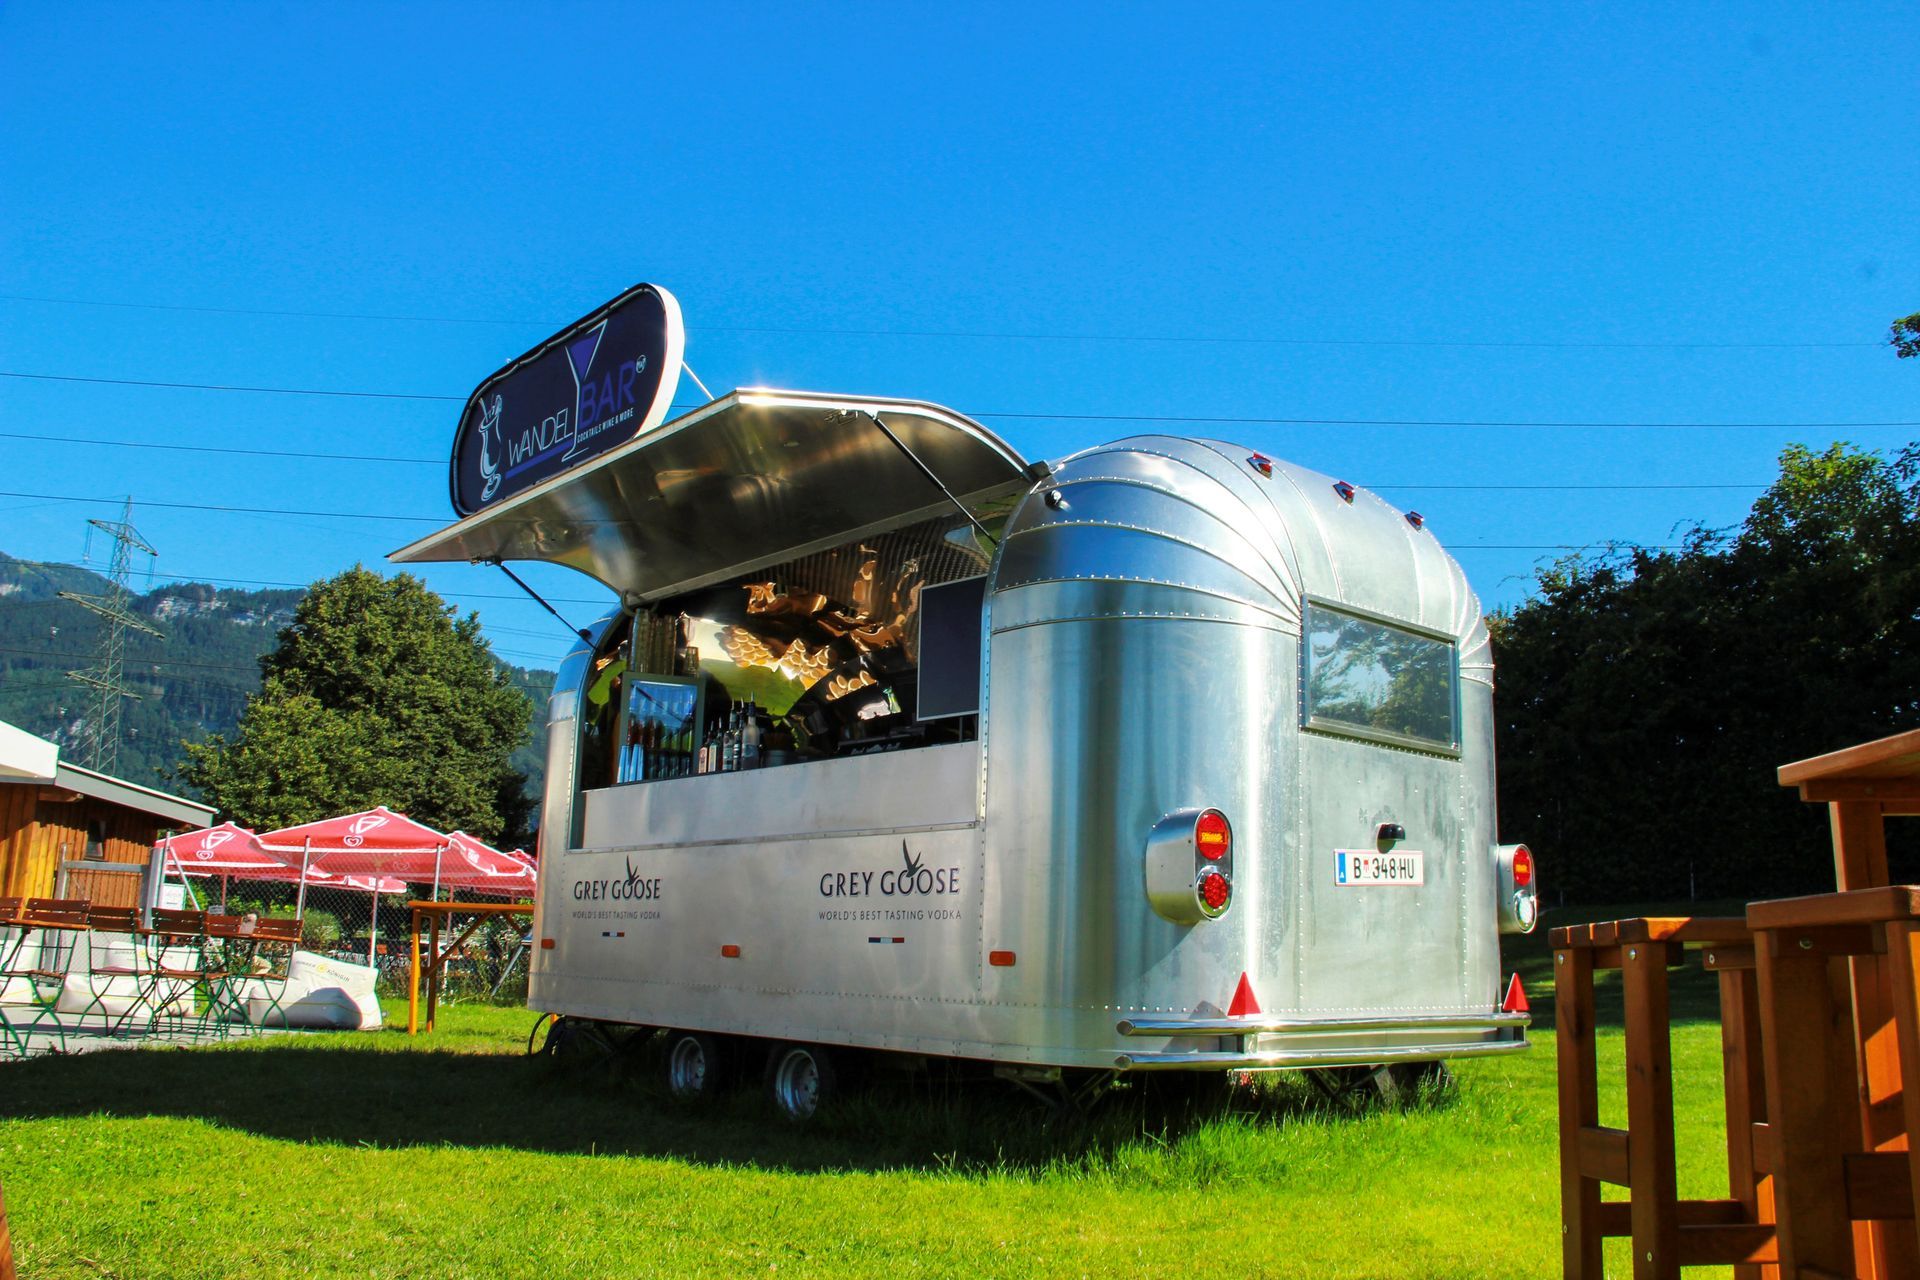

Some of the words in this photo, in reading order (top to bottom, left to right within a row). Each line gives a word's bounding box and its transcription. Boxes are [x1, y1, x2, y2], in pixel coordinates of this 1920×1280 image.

[579, 361, 636, 430] BAR
[619, 407, 634, 422] MORE
[508, 407, 574, 467] WANDEL
[1353, 857, 1361, 879] B
[574, 880, 608, 900] GREY
[612, 878, 661, 900] GOOSE
[820, 871, 874, 897] GREY
[880, 867, 960, 896] GOOSE
[598, 911, 613, 919] BEST
[613, 911, 638, 919] TASTING
[640, 911, 661, 919] VODKA
[819, 911, 857, 921] WORLD'S
[860, 910, 881, 920] BEST
[885, 910, 924, 920] TASTING
[928, 909, 961, 919] VODKA
